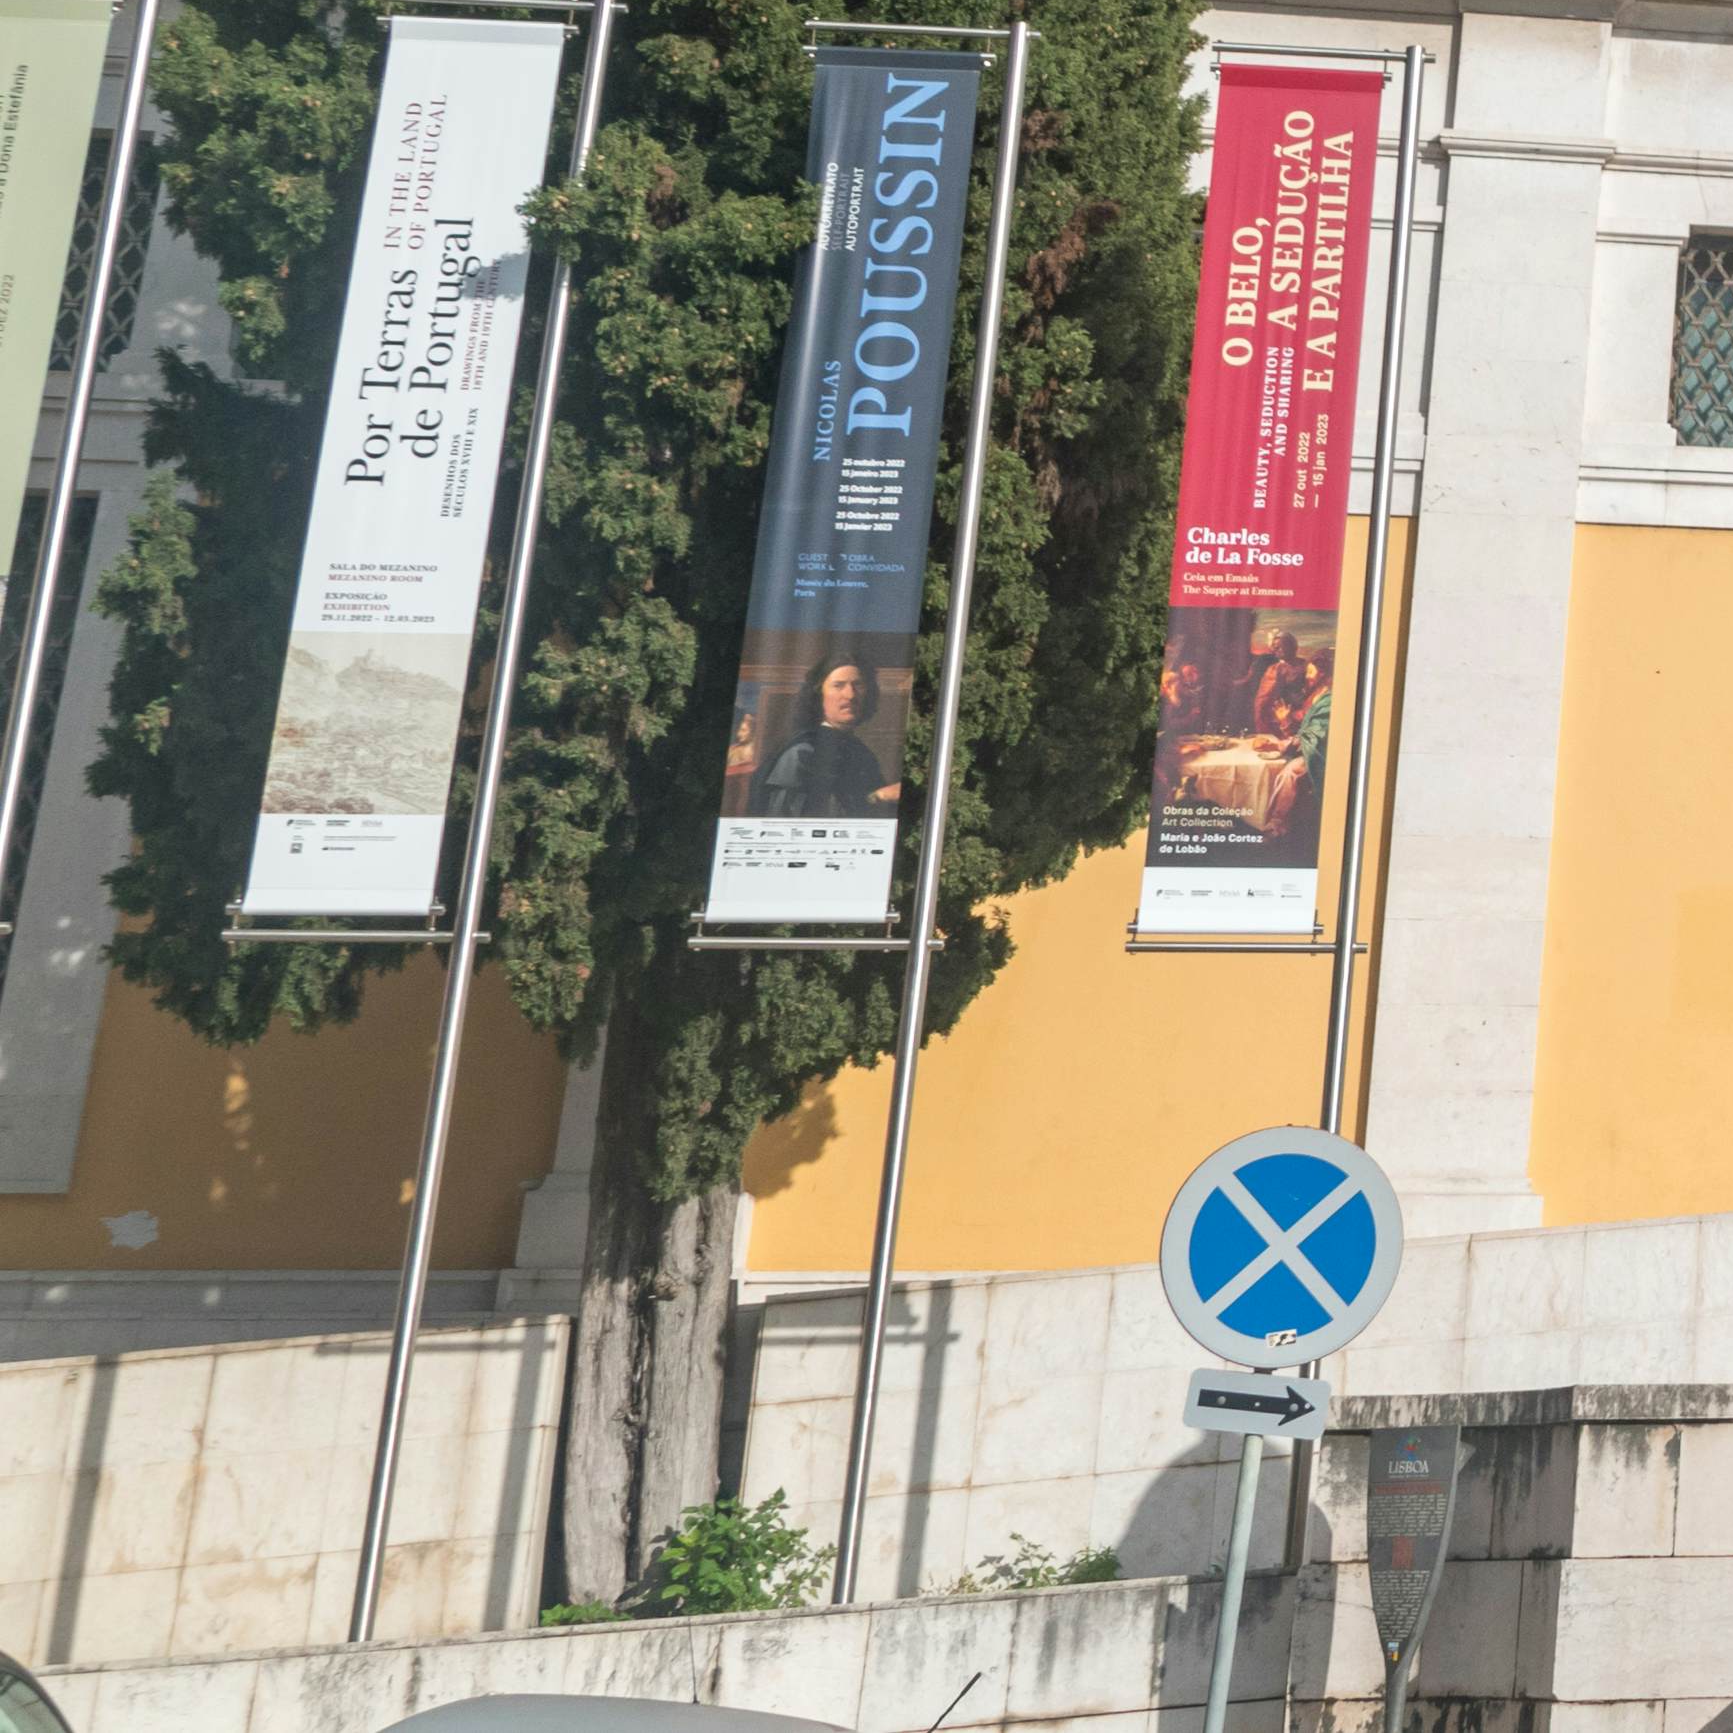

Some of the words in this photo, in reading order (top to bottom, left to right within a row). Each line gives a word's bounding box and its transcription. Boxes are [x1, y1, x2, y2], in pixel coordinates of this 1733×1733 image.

[397, 100, 424, 163] LAND
[414, 93, 449, 213] PORTUGAL
[389, 171, 412, 216] THE
[1270, 109, 1318, 294] SEDUÇÃO
[831, 173, 850, 252] SELF-PORTRAIT
[845, 166, 865, 252] AUTOPORTRAIT
[383, 225, 403, 250] IN
[407, 222, 427, 251] OF
[1308, 131, 1355, 321] PARTILHA
[846, 72, 950, 437] POUSSIN
[1224, 217, 1272, 327] BELO,
[408, 216, 482, 395] Portugal
[468, 302, 482, 334] FROM
[1267, 304, 1299, 331] A
[358, 268, 418, 401] Terras
[1306, 331, 1338, 359] A
[460, 335, 478, 391] DRAWINGS
[476, 339, 489, 363] AND
[1221, 336, 1253, 367] O
[1259, 345, 1281, 438] SEDUCTION
[1277, 345, 1295, 418] SHARING
[1302, 368, 1334, 393] E
[467, 407, 479, 427] XIX
[813, 359, 842, 461] NICOLAS
[399, 408, 443, 460] de
[465, 428, 475, 436] E
[1273, 422, 1290, 457] AND
[1315, 413, 1330, 445] 2023
[343, 413, 394, 486] Por
[460, 438, 474, 466] XVIII
[1297, 432, 1311, 464] 2022
[1313, 450, 1328, 472] jan
[439, 459, 459, 518] DESENHOS
[449, 433, 462, 457] DOS
[850, 484, 883, 493] October
[1253, 442, 1273, 509] BEAUTY,
[1296, 468, 1309, 491] out
[452, 468, 469, 518] SÉCULOS
[1293, 493, 1305, 509] 27
[1187, 527, 1271, 546] Charles
[329, 562, 357, 571] SALA
[359, 563, 377, 572] DO
[379, 563, 438, 573] MEZANINO
[798, 553, 828, 562] GUEST
[798, 563, 826, 571] WORK
[847, 563, 905, 573] CONVIDADA
[848, 554, 876, 563] OBRA
[1185, 546, 1212, 564] de
[1216, 547, 1242, 565] La
[1247, 548, 1305, 566] Fosse
[328, 573, 387, 582] MEZANINO
[390, 575, 424, 583] ROOM
[1182, 585, 1201, 595] The
[1203, 585, 1239, 597] Supper
[1239, 587, 1250, 595] at
[1251, 587, 1294, 596] Emmaus
[1183, 572, 1206, 582] Ceia
[1207, 574, 1224, 583] em
[1225, 573, 1260, 583] Emaús
[323, 602, 391, 612] EXHIBITION
[794, 589, 816, 597] Paris
[1161, 817, 1177, 827] Art
[1179, 817, 1234, 828] Collection
[1163, 805, 1194, 816] Obras
[1195, 806, 1210, 816] da
[1211, 806, 1254, 817] Coleção
[1159, 844, 1173, 854] de
[1175, 844, 1208, 854] Lobão
[1160, 832, 1190, 843] Maria
[1191, 835, 1200, 843] e
[1201, 832, 1226, 843] João
[1228, 833, 1264, 844] Cortez
[1388, 1459, 1429, 1474] LISBOA
